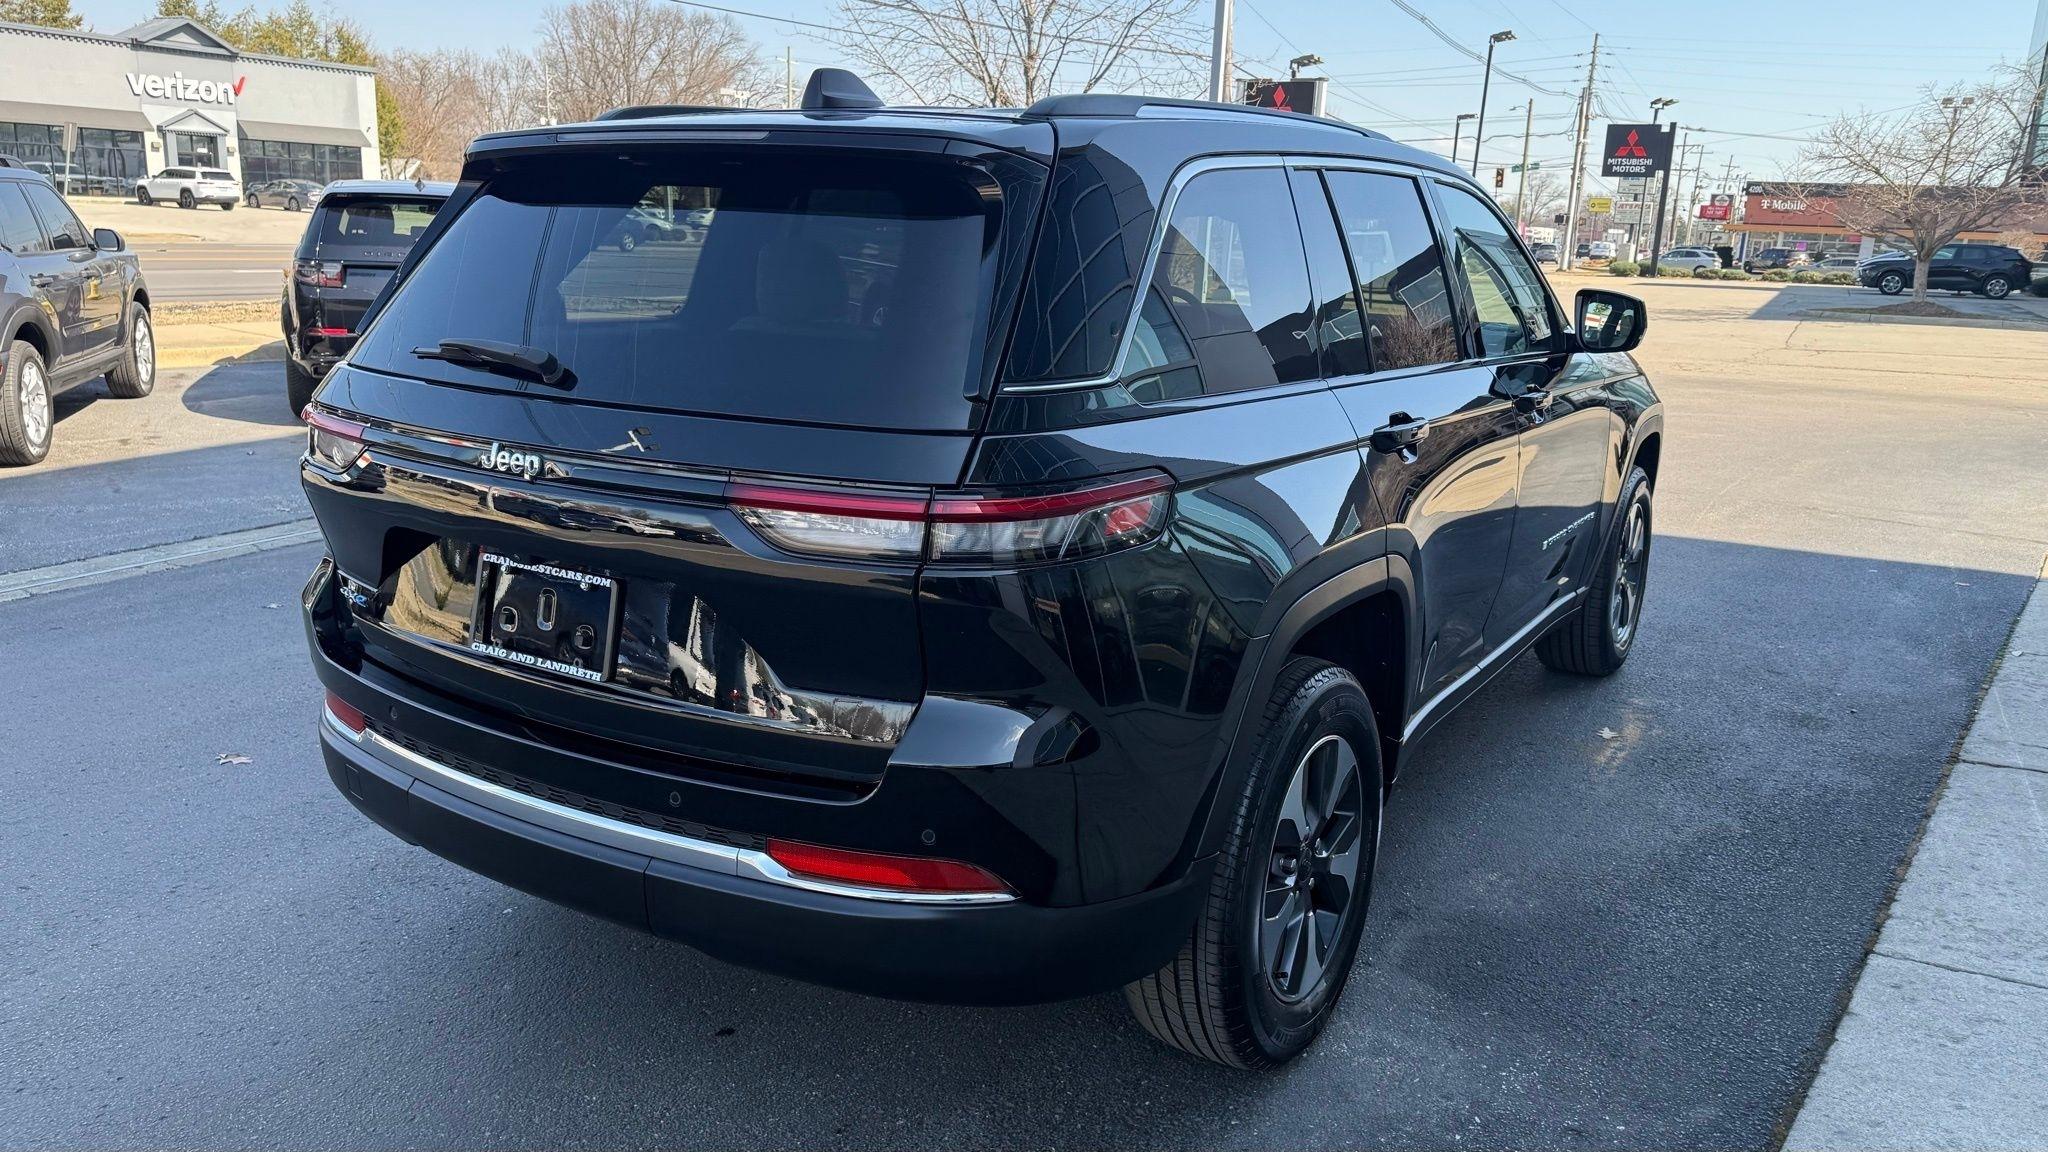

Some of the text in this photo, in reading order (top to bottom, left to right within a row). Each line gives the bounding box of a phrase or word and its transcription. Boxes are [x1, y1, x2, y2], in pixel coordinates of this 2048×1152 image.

[126, 71, 235, 105] verizon
[1607, 158, 1653, 166] MITSUBISHI
[1612, 165, 1646, 173] MOTORS
[480, 440, 541, 481] Jeep
[471, 642, 602, 682] CRAIG AND LANDRETH
